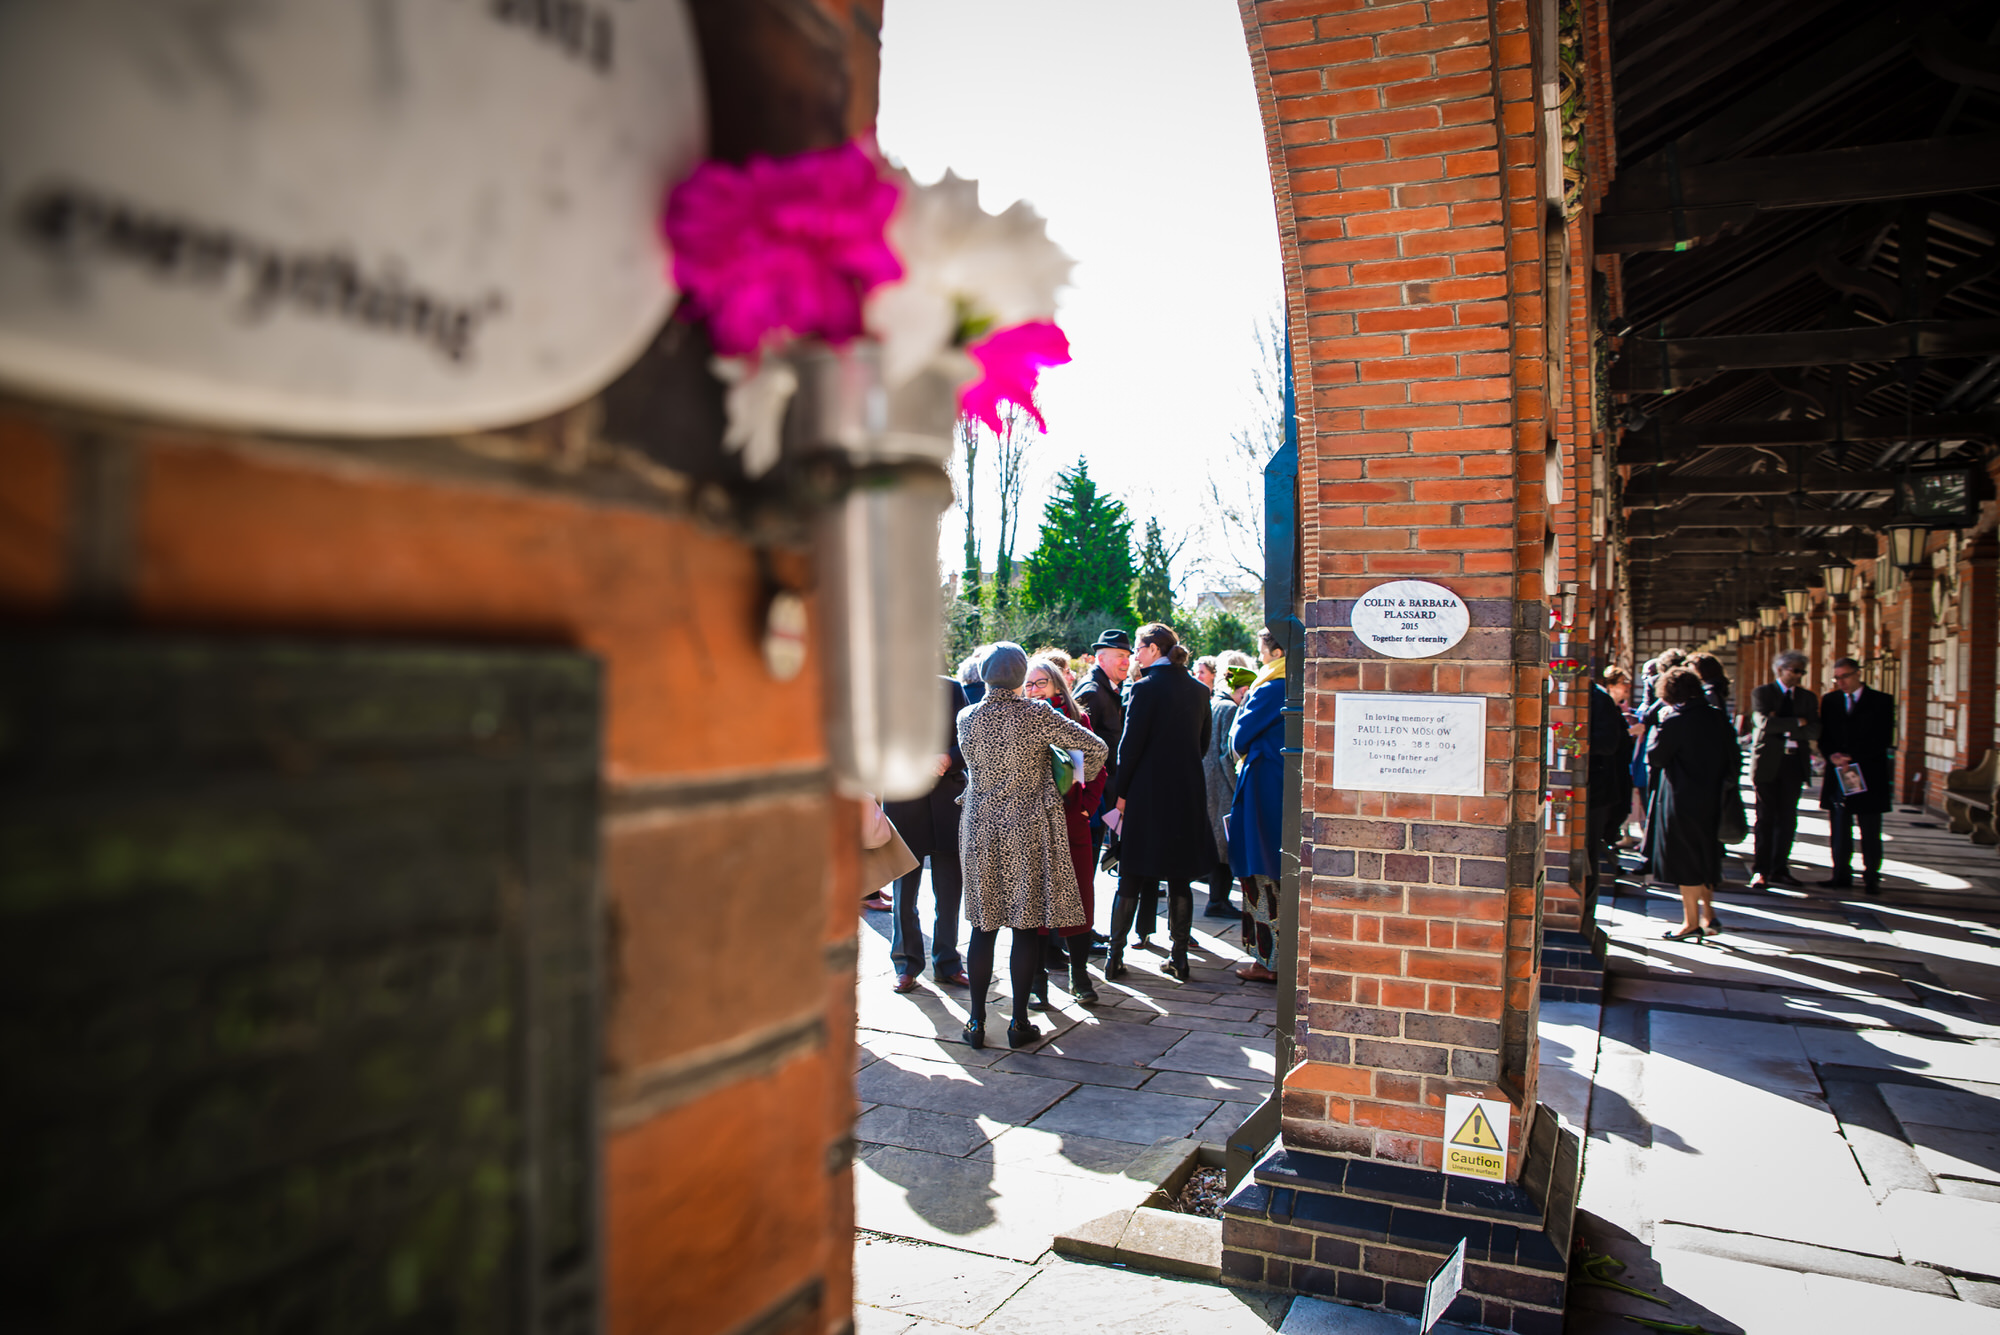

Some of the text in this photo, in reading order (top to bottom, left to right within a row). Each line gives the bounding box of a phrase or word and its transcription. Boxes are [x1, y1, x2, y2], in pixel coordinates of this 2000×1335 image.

[1364, 599, 1457, 608] COLIN & BARBARA
[1384, 611, 1437, 619] PLASSARD
[1372, 635, 1448, 644] Together for eternity
[1365, 713, 1374, 721] In
[1375, 714, 1400, 722] loving
[1402, 715, 1434, 724] memory
[1358, 725, 1382, 734] PAUL
[1369, 752, 1396, 761] Loving
[1398, 753, 1422, 762] father
[1379, 766, 1427, 775] grandfather
[1450, 1151, 1501, 1169] Caution
